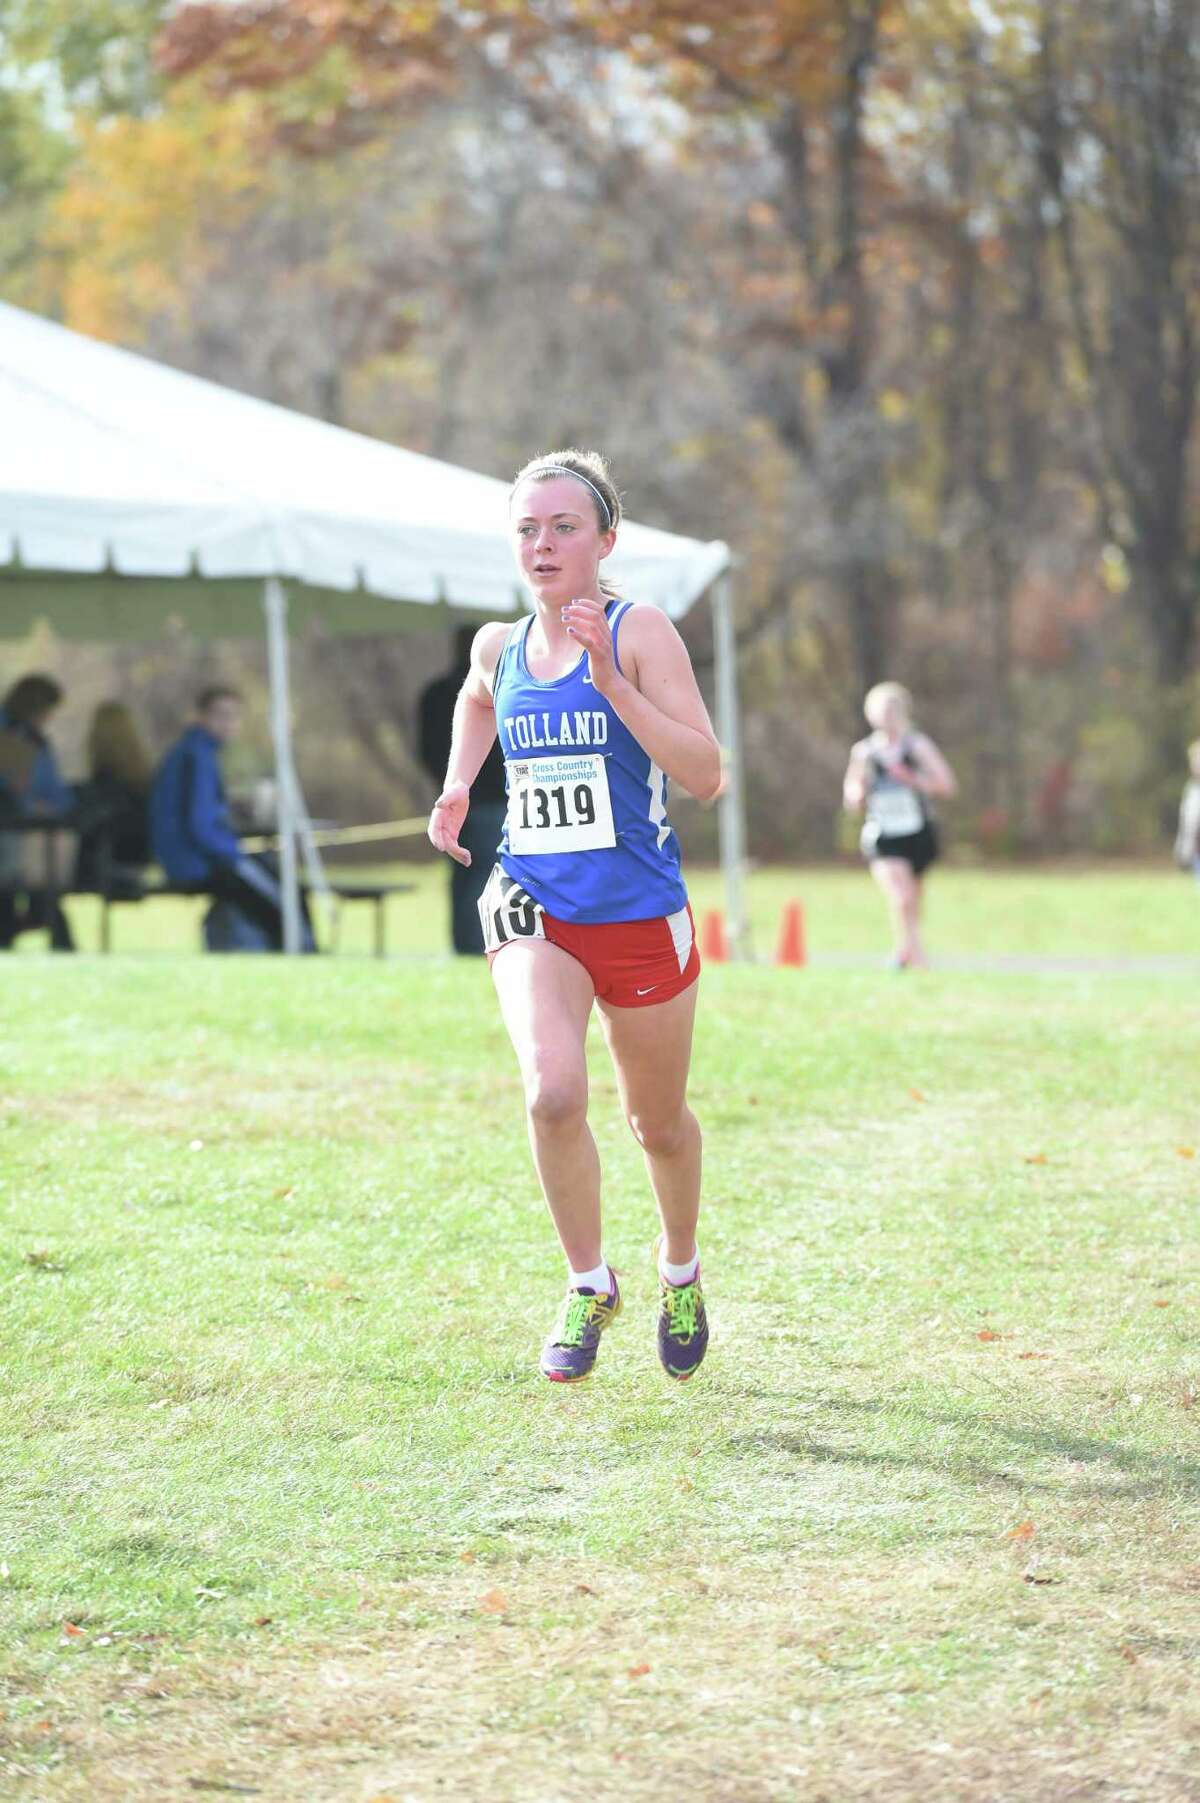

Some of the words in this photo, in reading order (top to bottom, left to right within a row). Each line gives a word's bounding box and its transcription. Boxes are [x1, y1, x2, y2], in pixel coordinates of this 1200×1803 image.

[504, 711, 608, 751] TOLLAND
[532, 763, 555, 773] Cross
[556, 759, 594, 771] Country
[532, 769, 598, 783] Championships
[519, 784, 596, 829] 1319
